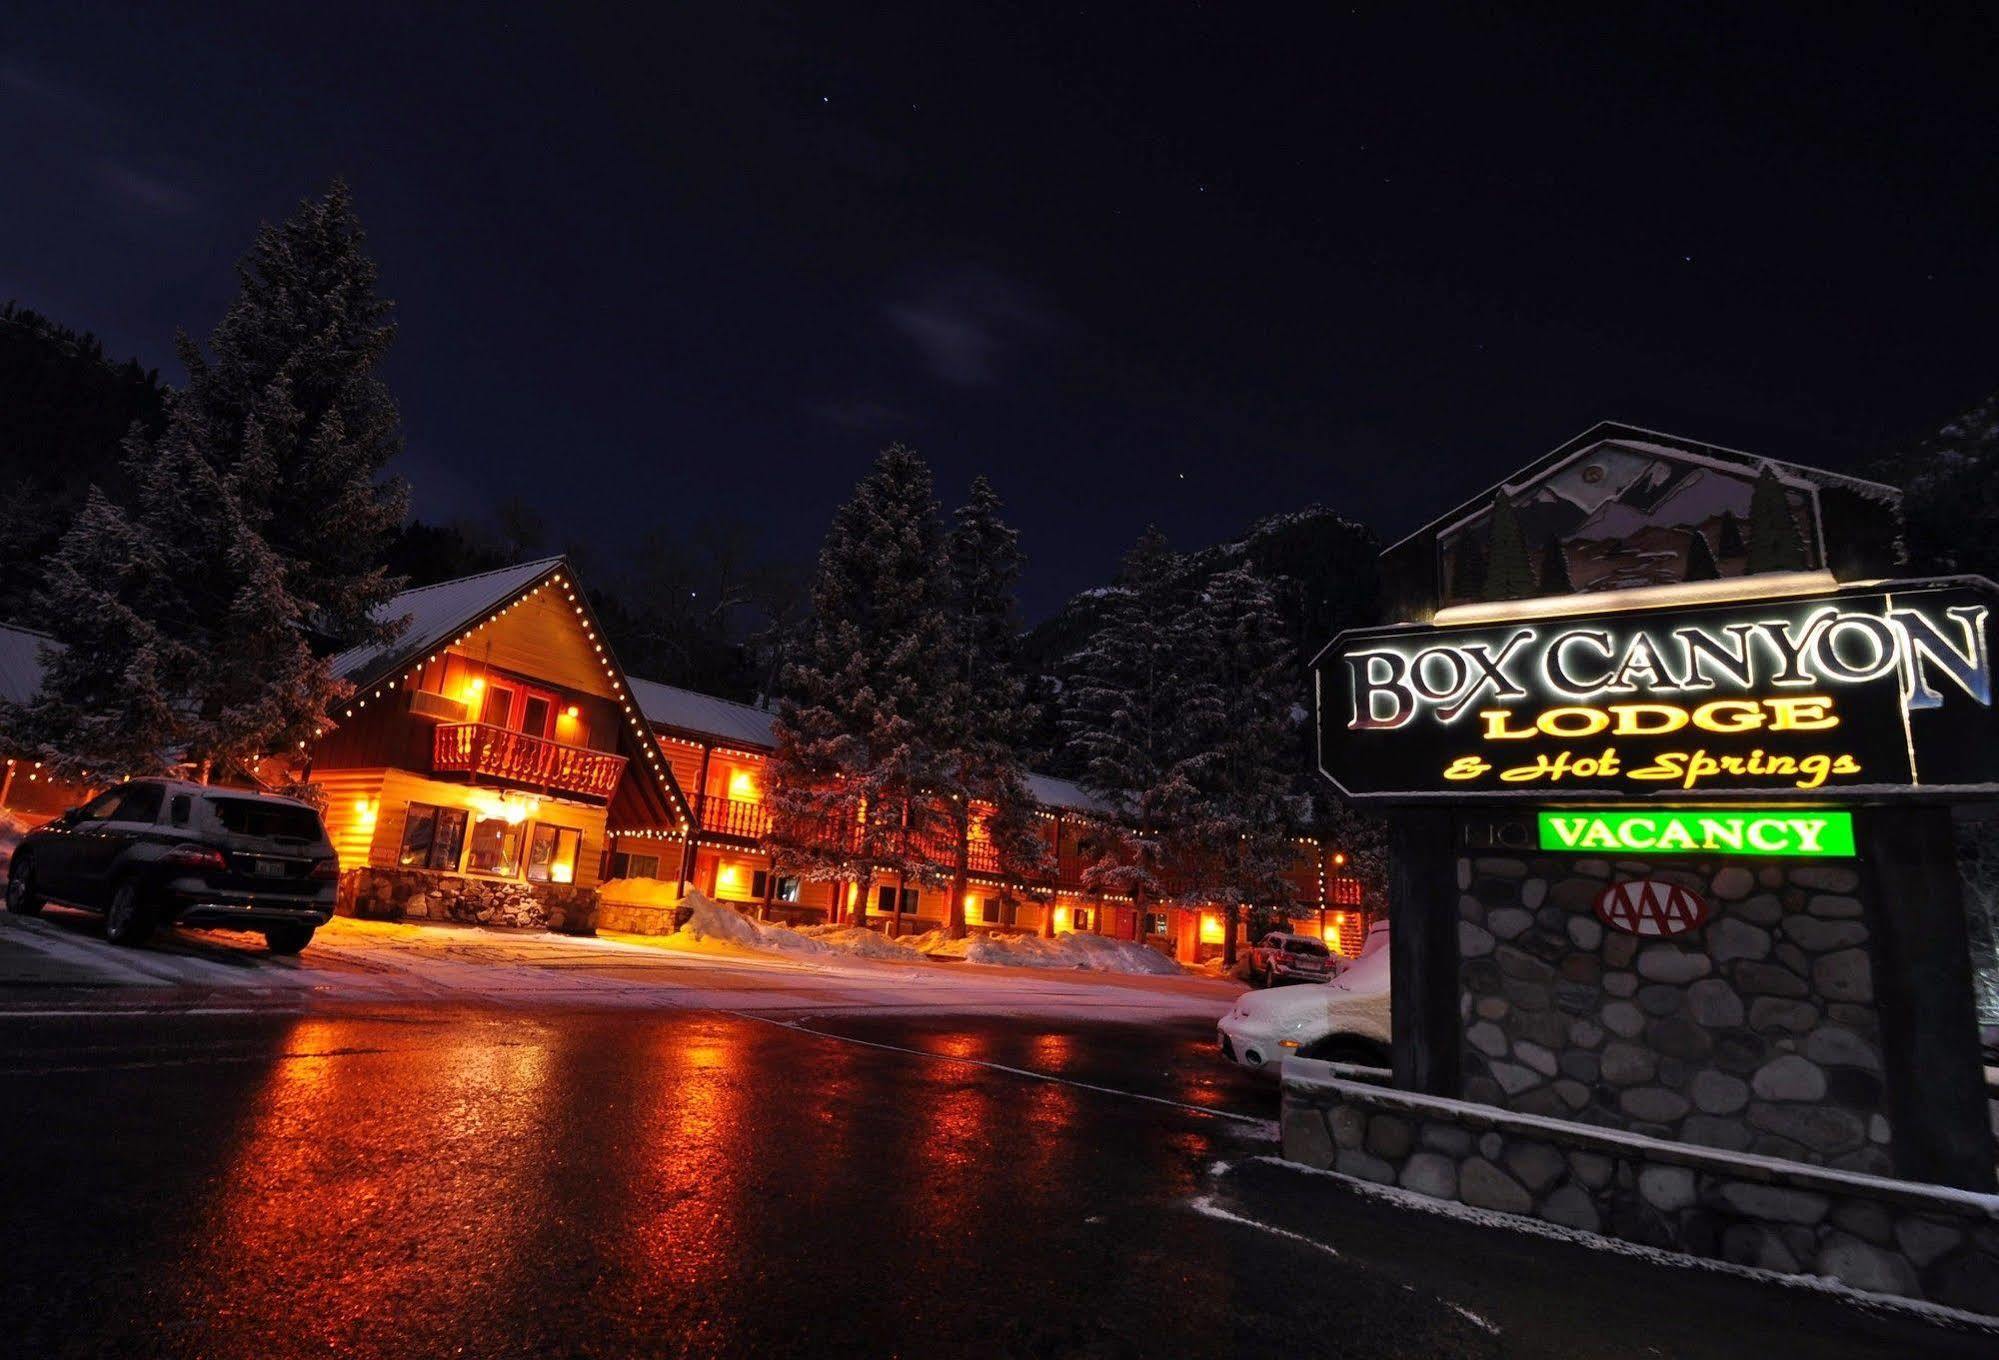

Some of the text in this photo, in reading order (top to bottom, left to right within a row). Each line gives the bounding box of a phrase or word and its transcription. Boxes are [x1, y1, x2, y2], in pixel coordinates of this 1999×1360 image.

[1343, 606, 1993, 731] BOX CANYON
[1480, 696, 1840, 740] LODGE
[1443, 747, 1861, 790] & Hot Springs
[1547, 816, 1828, 853] VACANCY
[1605, 882, 1700, 934] AAA
